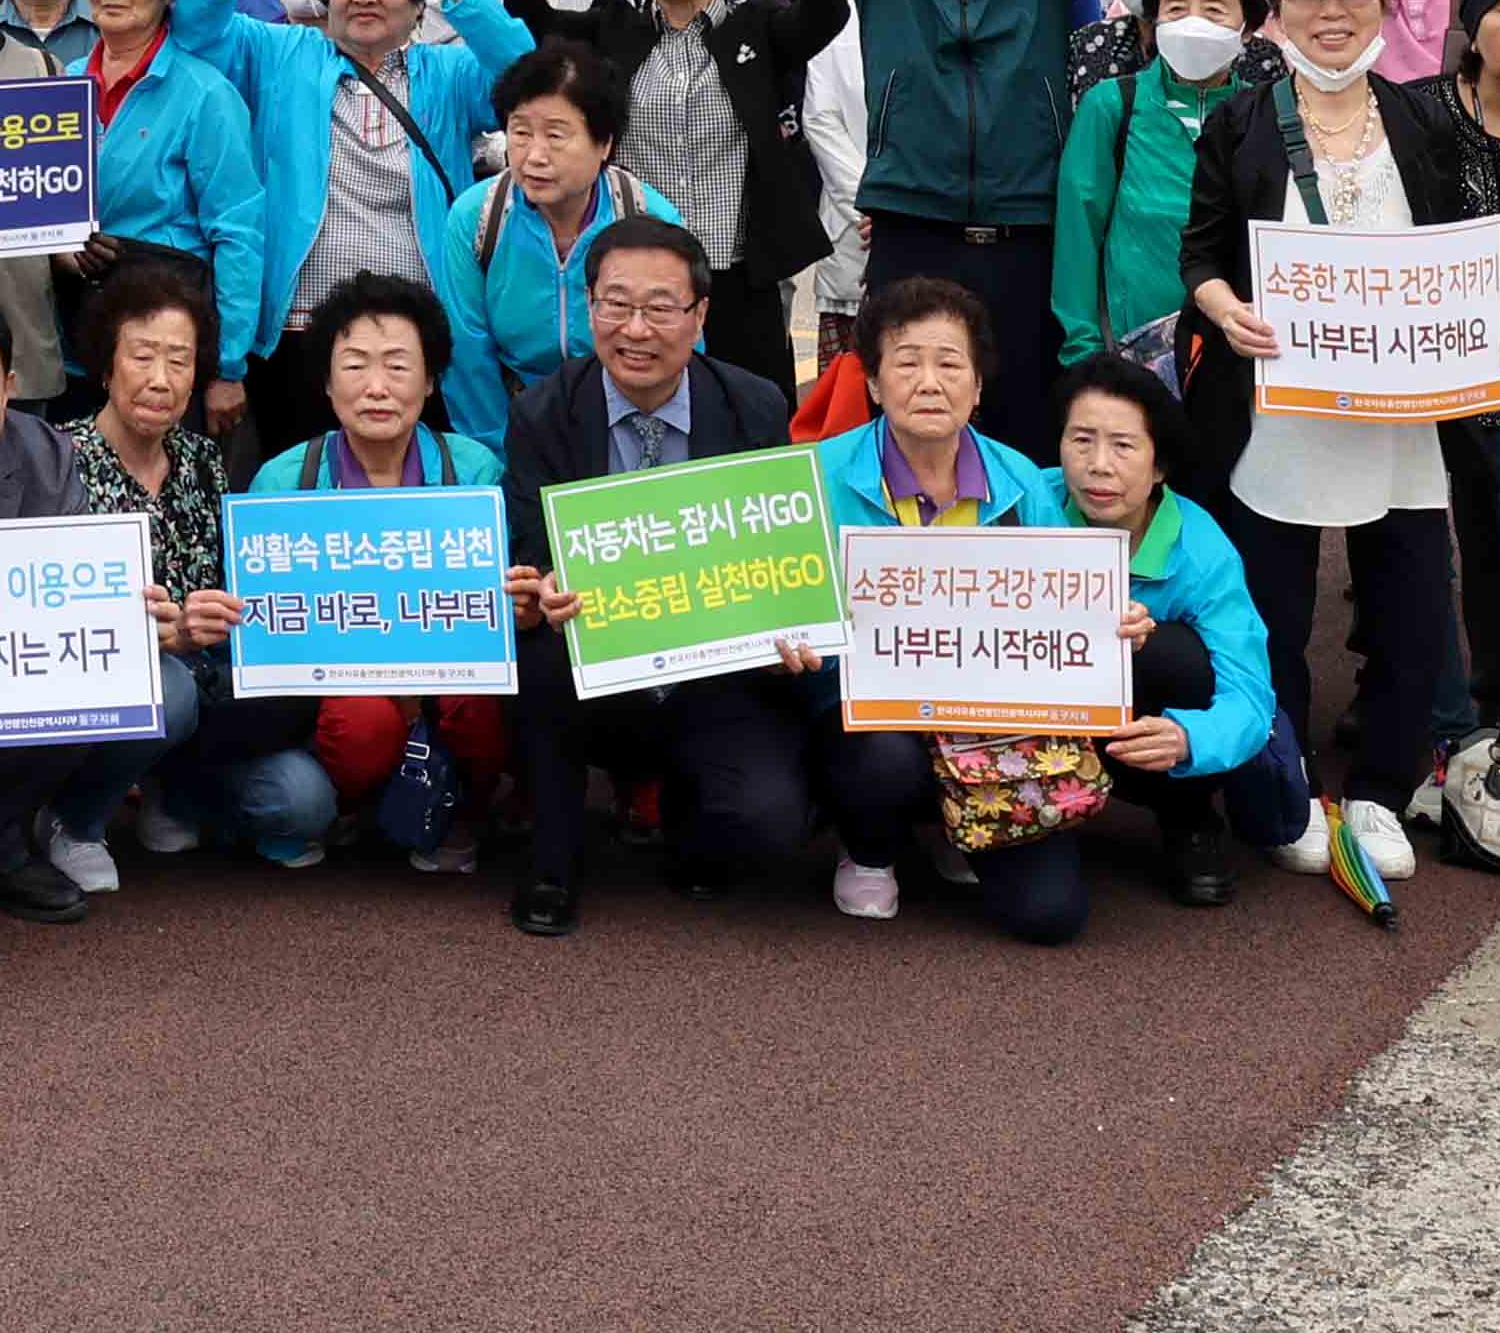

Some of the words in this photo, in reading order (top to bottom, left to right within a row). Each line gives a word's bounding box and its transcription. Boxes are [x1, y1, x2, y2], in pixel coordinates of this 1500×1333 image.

[1266, 262, 1336, 303] 소중한
[1343, 266, 1392, 306] 지구
[1400, 264, 1443, 306] 건강
[1449, 254, 1499, 299] 지키기
[1290, 320, 1379, 364] 나부터
[1388, 318, 1488, 363] 시작해요
[238, 532, 320, 573] 생활속
[325, 530, 432, 571] 탄소중립
[440, 527, 494, 569] 실천
[566, 512, 675, 565] 자동차는
[679, 497, 737, 547] 잠시
[741, 491, 813, 534] 쉬GO
[8, 561, 132, 608] 이용으로
[696, 554, 825, 610] 실천하GO
[852, 568, 925, 607] 소중한
[931, 568, 980, 607] 지구
[986, 568, 1036, 610] 건강
[1042, 569, 1114, 611] 지키기
[244, 593, 308, 635] 지금
[316, 591, 392, 634] 바로,
[399, 589, 498, 630] 나부터
[58, 628, 121, 673] 지구
[873, 626, 962, 668] 나부터
[971, 628, 1093, 670] 시작해요
